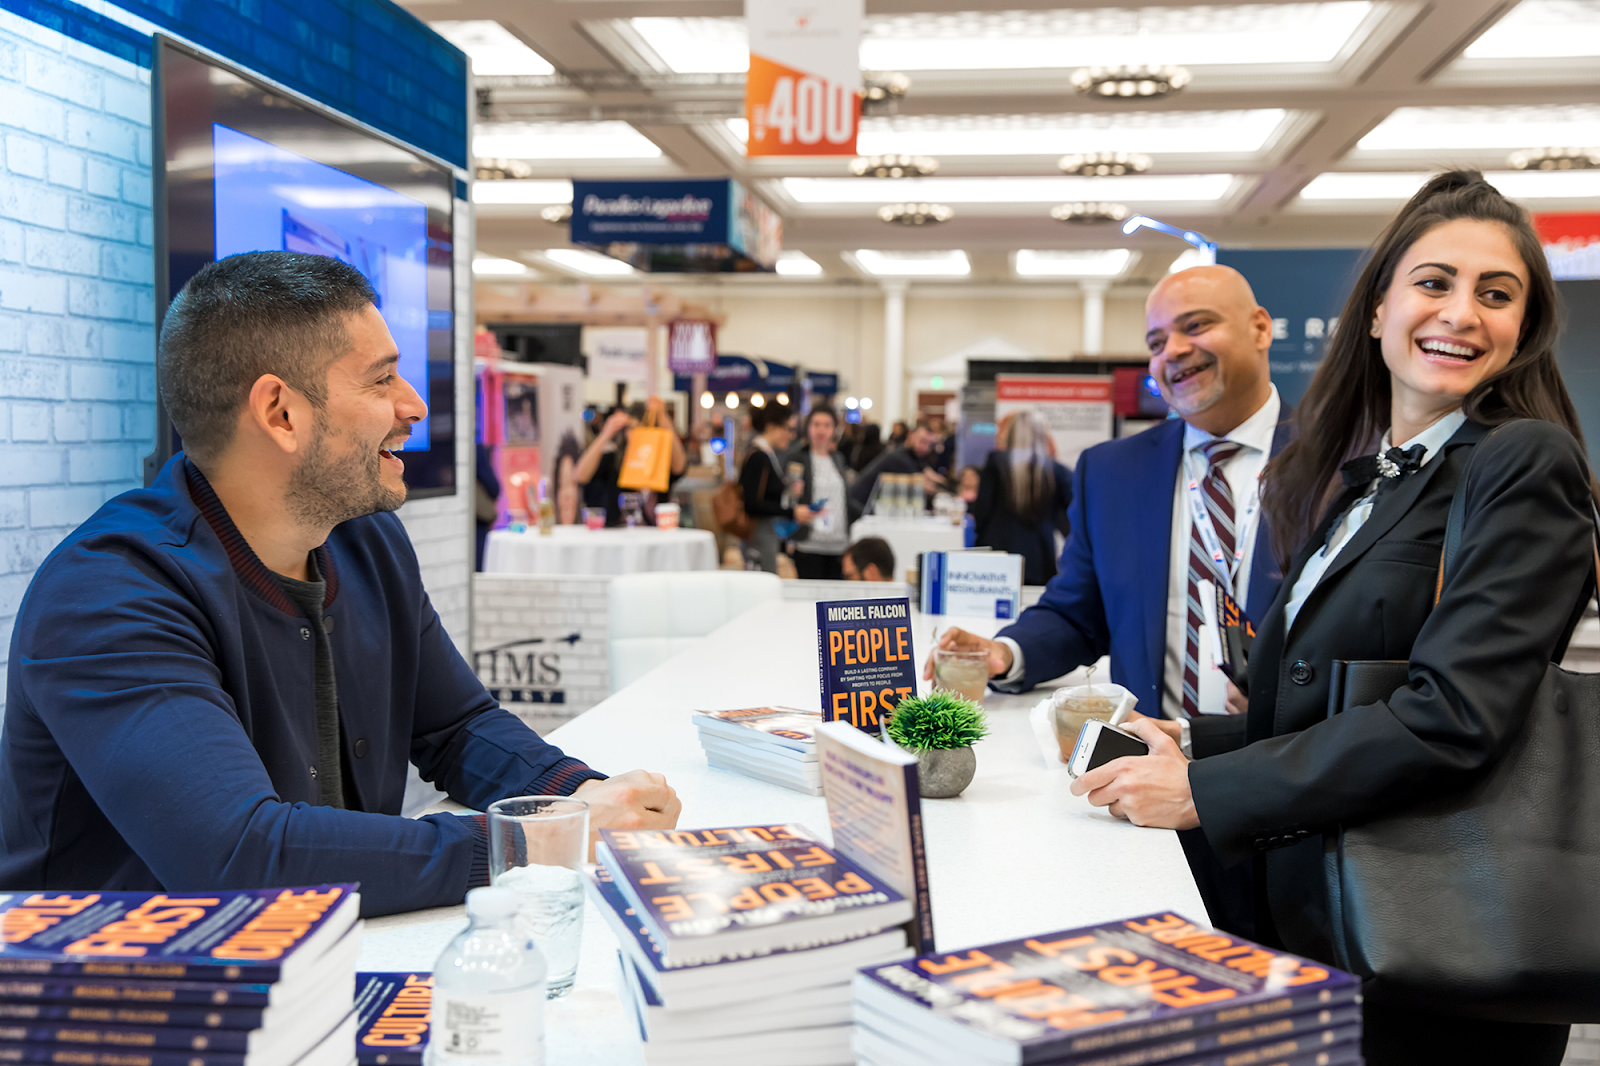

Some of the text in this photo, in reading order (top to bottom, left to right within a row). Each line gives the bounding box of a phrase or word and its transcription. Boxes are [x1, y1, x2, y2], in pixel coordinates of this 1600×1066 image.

[769, 77, 854, 143] 400
[828, 604, 907, 621] MICHEL FALCON
[829, 627, 910, 666] PEOPLE
[498, 687, 554, 703] OST
[610, 825, 801, 850] CULTURE
[639, 846, 836, 885] FIRST
[651, 871, 873, 922] PEOPLE
[64, 894, 220, 957] FIRST
[211, 888, 343, 960] CULTURE
[1025, 935, 1236, 1008] FIRST
